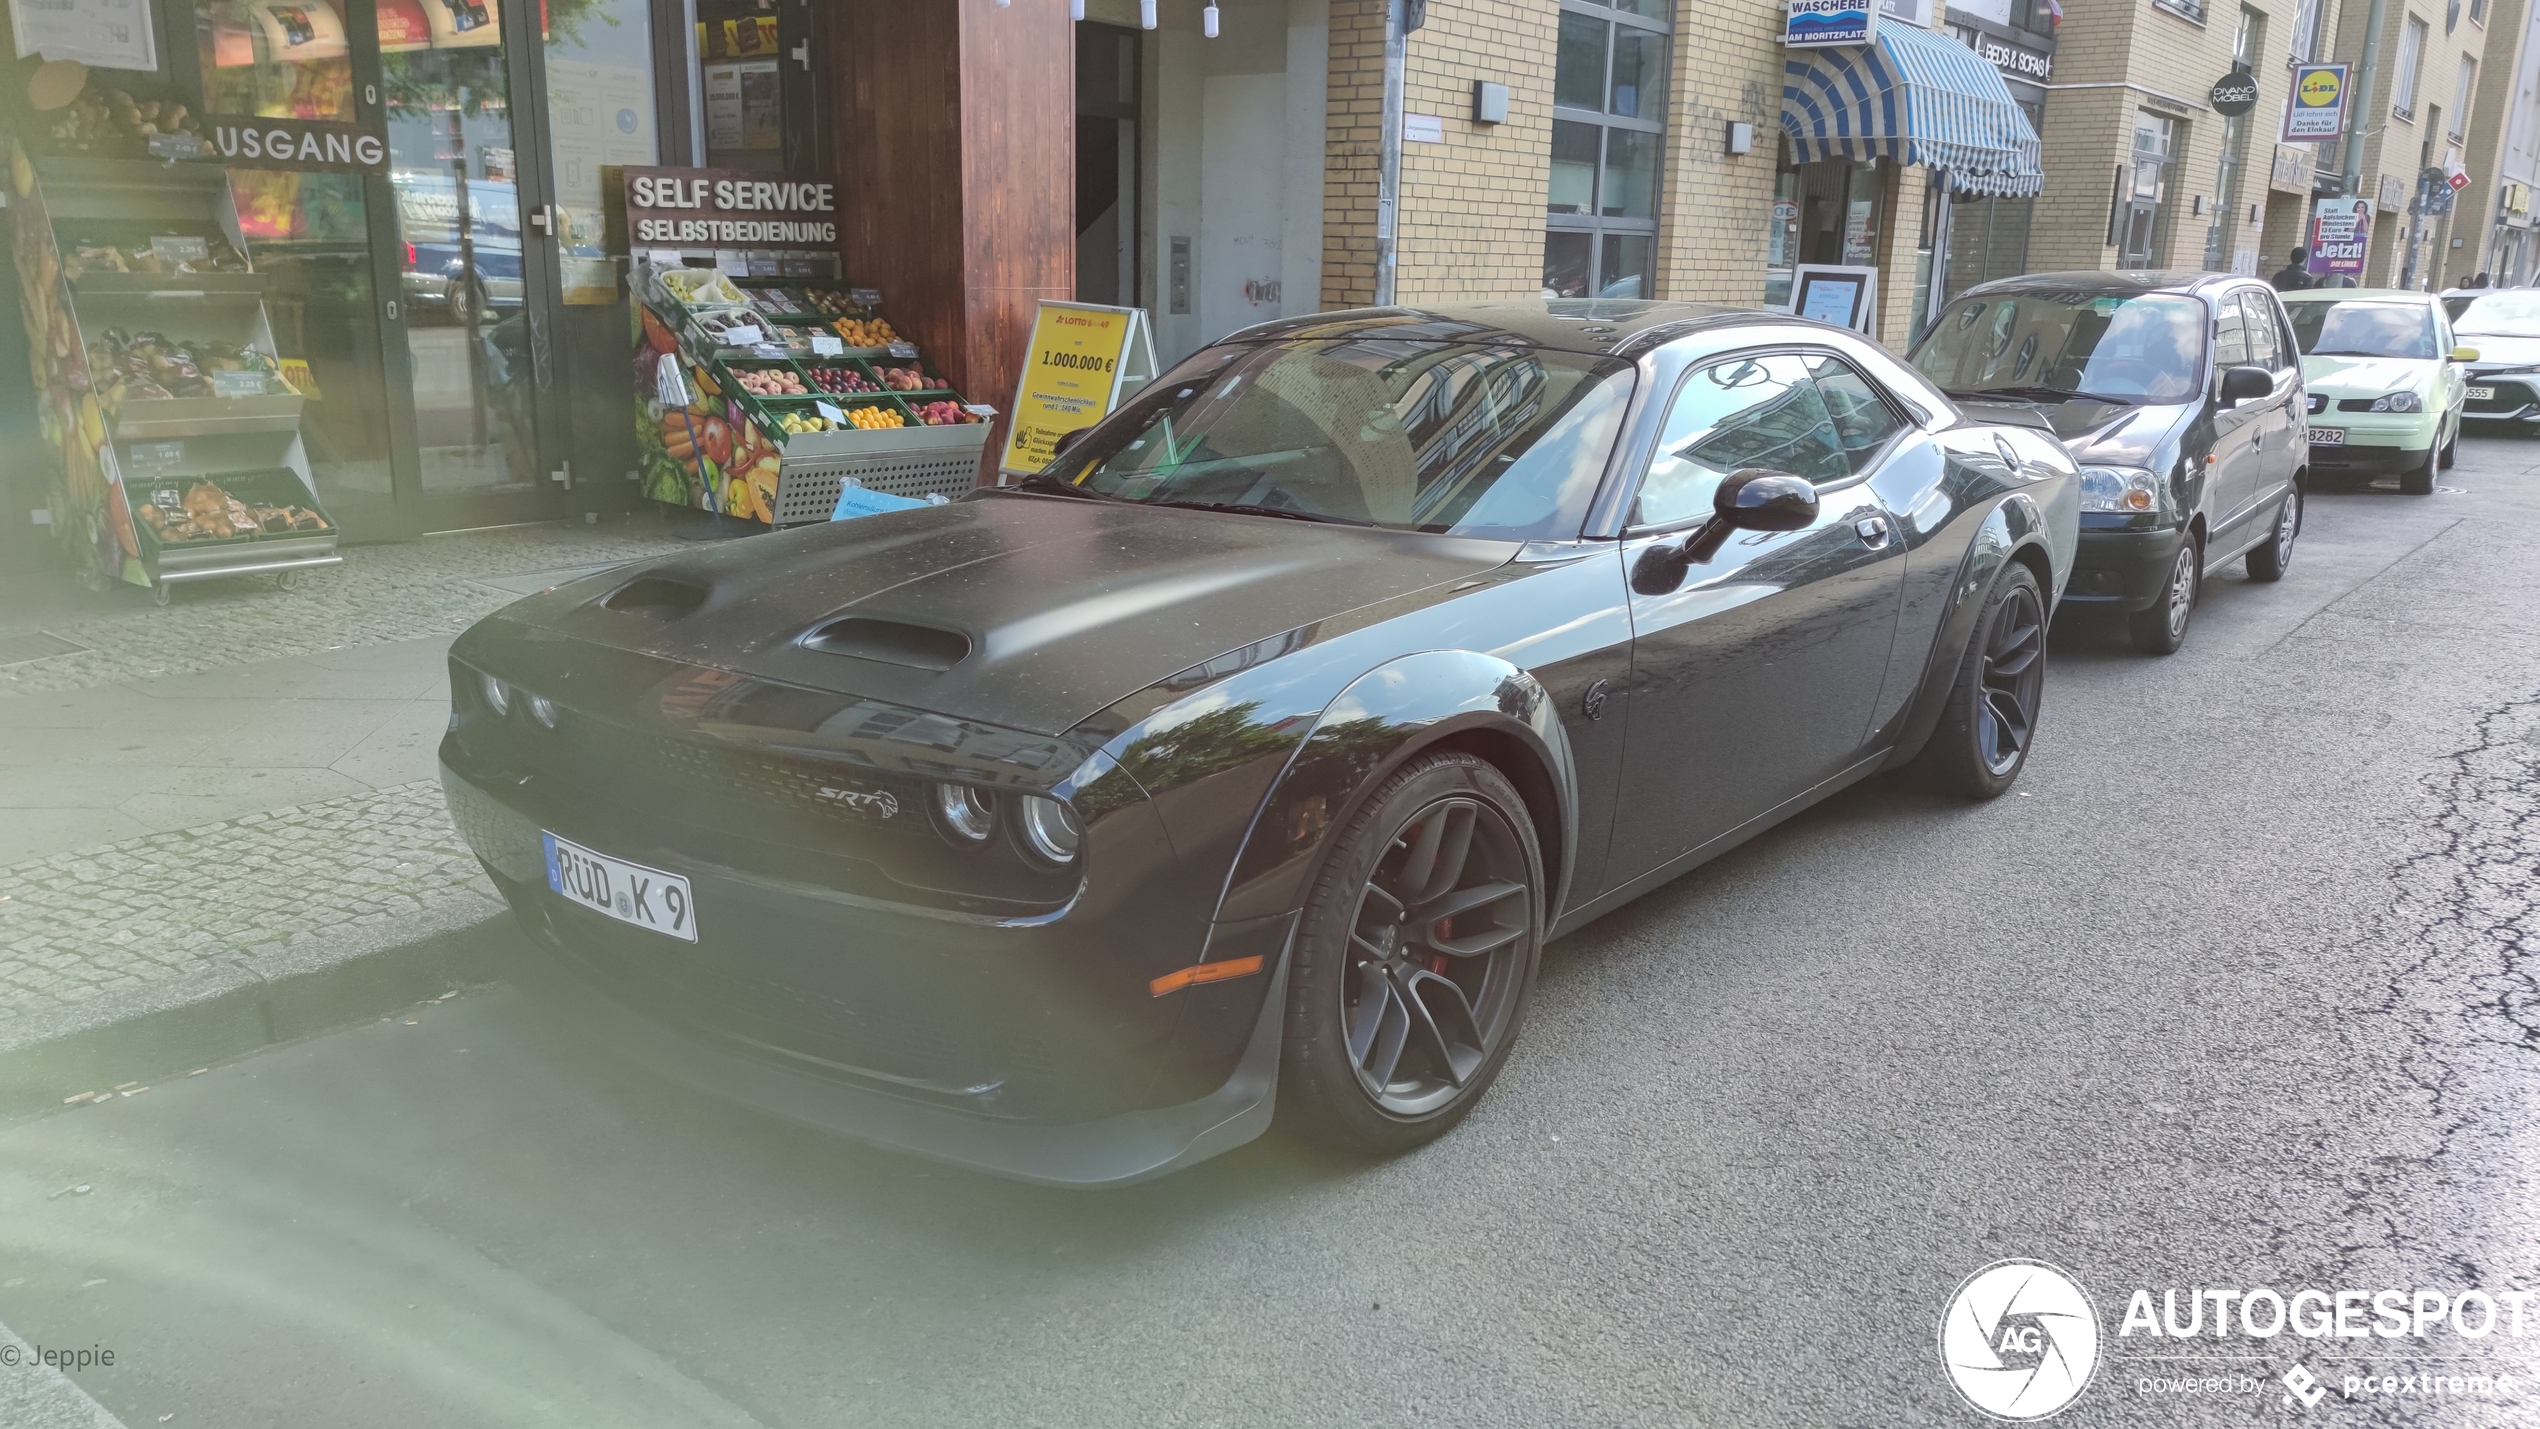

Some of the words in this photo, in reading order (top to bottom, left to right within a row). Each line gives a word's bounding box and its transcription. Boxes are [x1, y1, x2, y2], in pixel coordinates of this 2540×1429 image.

[1805, 30, 1867, 40] MORITZPLATZ
[1986, 43, 2009, 66] BEDS
[2010, 50, 2017, 69] &
[2018, 52, 2045, 77] SOFAS
[2213, 86, 2255, 95] DIVANO
[216, 126, 383, 165] USGANG
[632, 177, 710, 209] SELF
[713, 180, 835, 212] SERVICE
[637, 219, 837, 243] SELBSTBEDIENUNG
[2315, 242, 2363, 258] Jetzt!
[1065, 317, 1087, 326] LOTTO
[1101, 321, 1110, 329] 49
[1042, 351, 1103, 372] 1.000.000
[1105, 358, 1114, 373] €
[1032, 391, 1096, 407] Gewinnwahrscheinlichkeit
[2308, 429, 2343, 442] 8282
[816, 787, 881, 807] SRT
[551, 869, 558, 882] D
[557, 846, 612, 909] RÜD
[630, 874, 656, 924] K
[665, 885, 686, 931] 9
